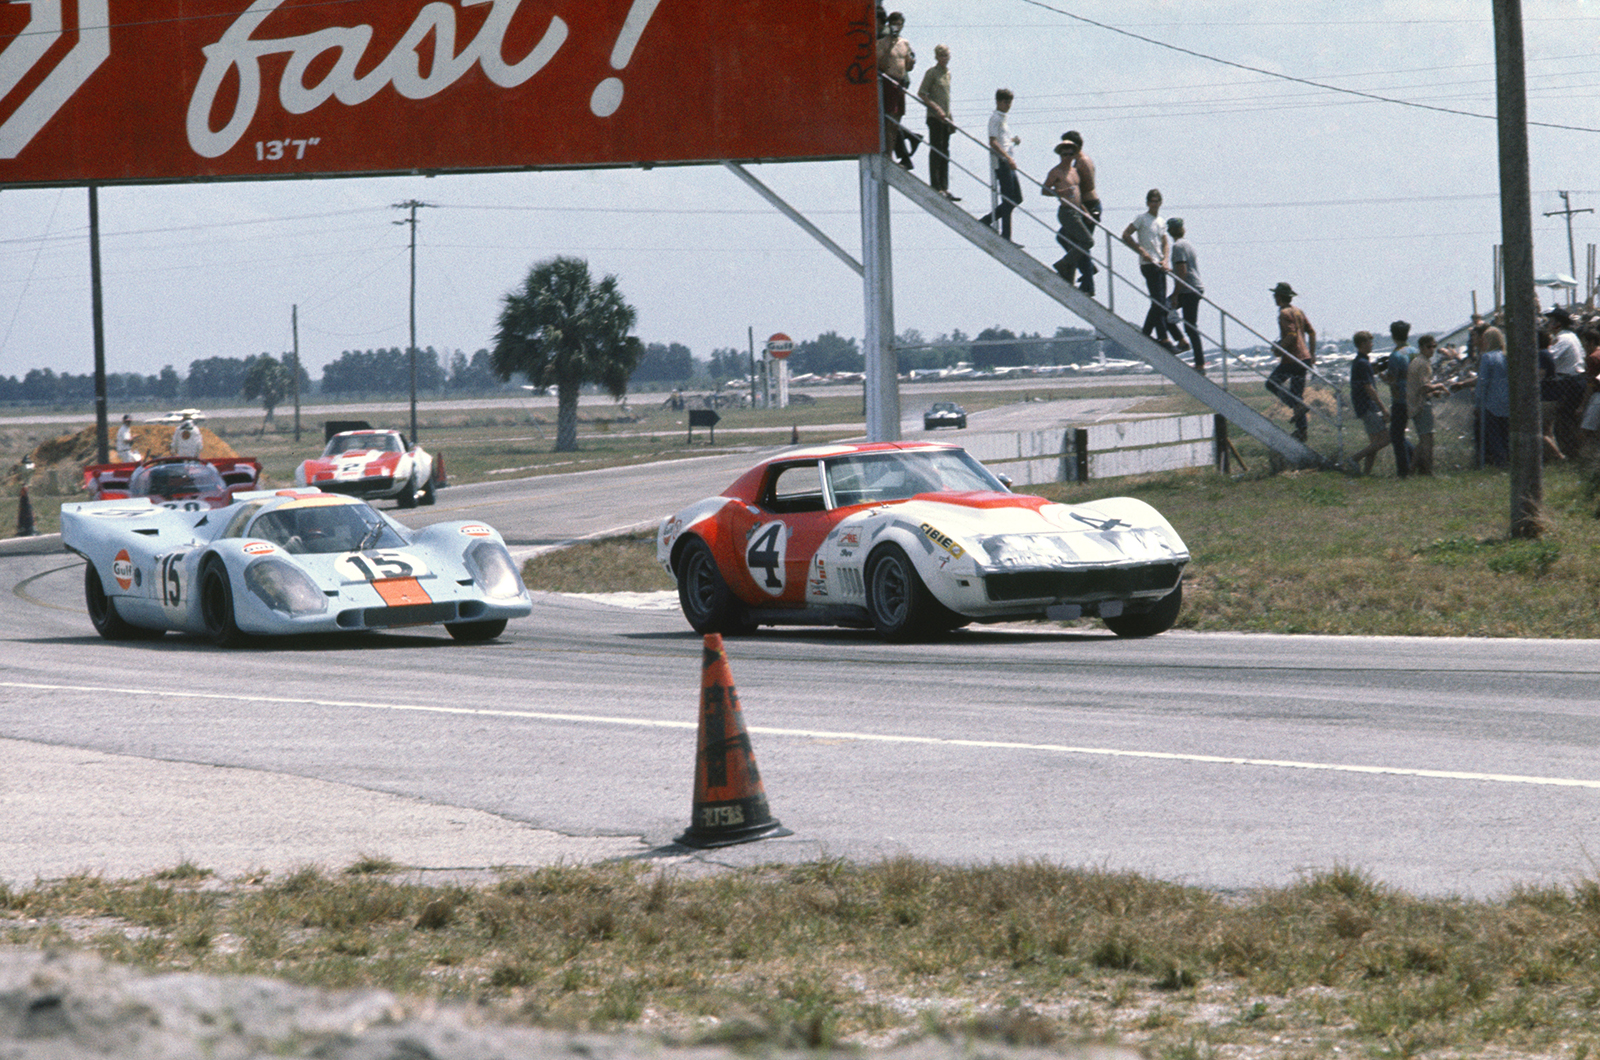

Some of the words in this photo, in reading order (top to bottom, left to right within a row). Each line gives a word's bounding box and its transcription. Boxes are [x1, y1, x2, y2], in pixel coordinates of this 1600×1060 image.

[1069, 512, 1132, 531] 4
[113, 562, 133, 576] Gulf
[346, 553, 413, 580] 15
[748, 523, 783, 588] 4
[162, 553, 186, 607] 15
